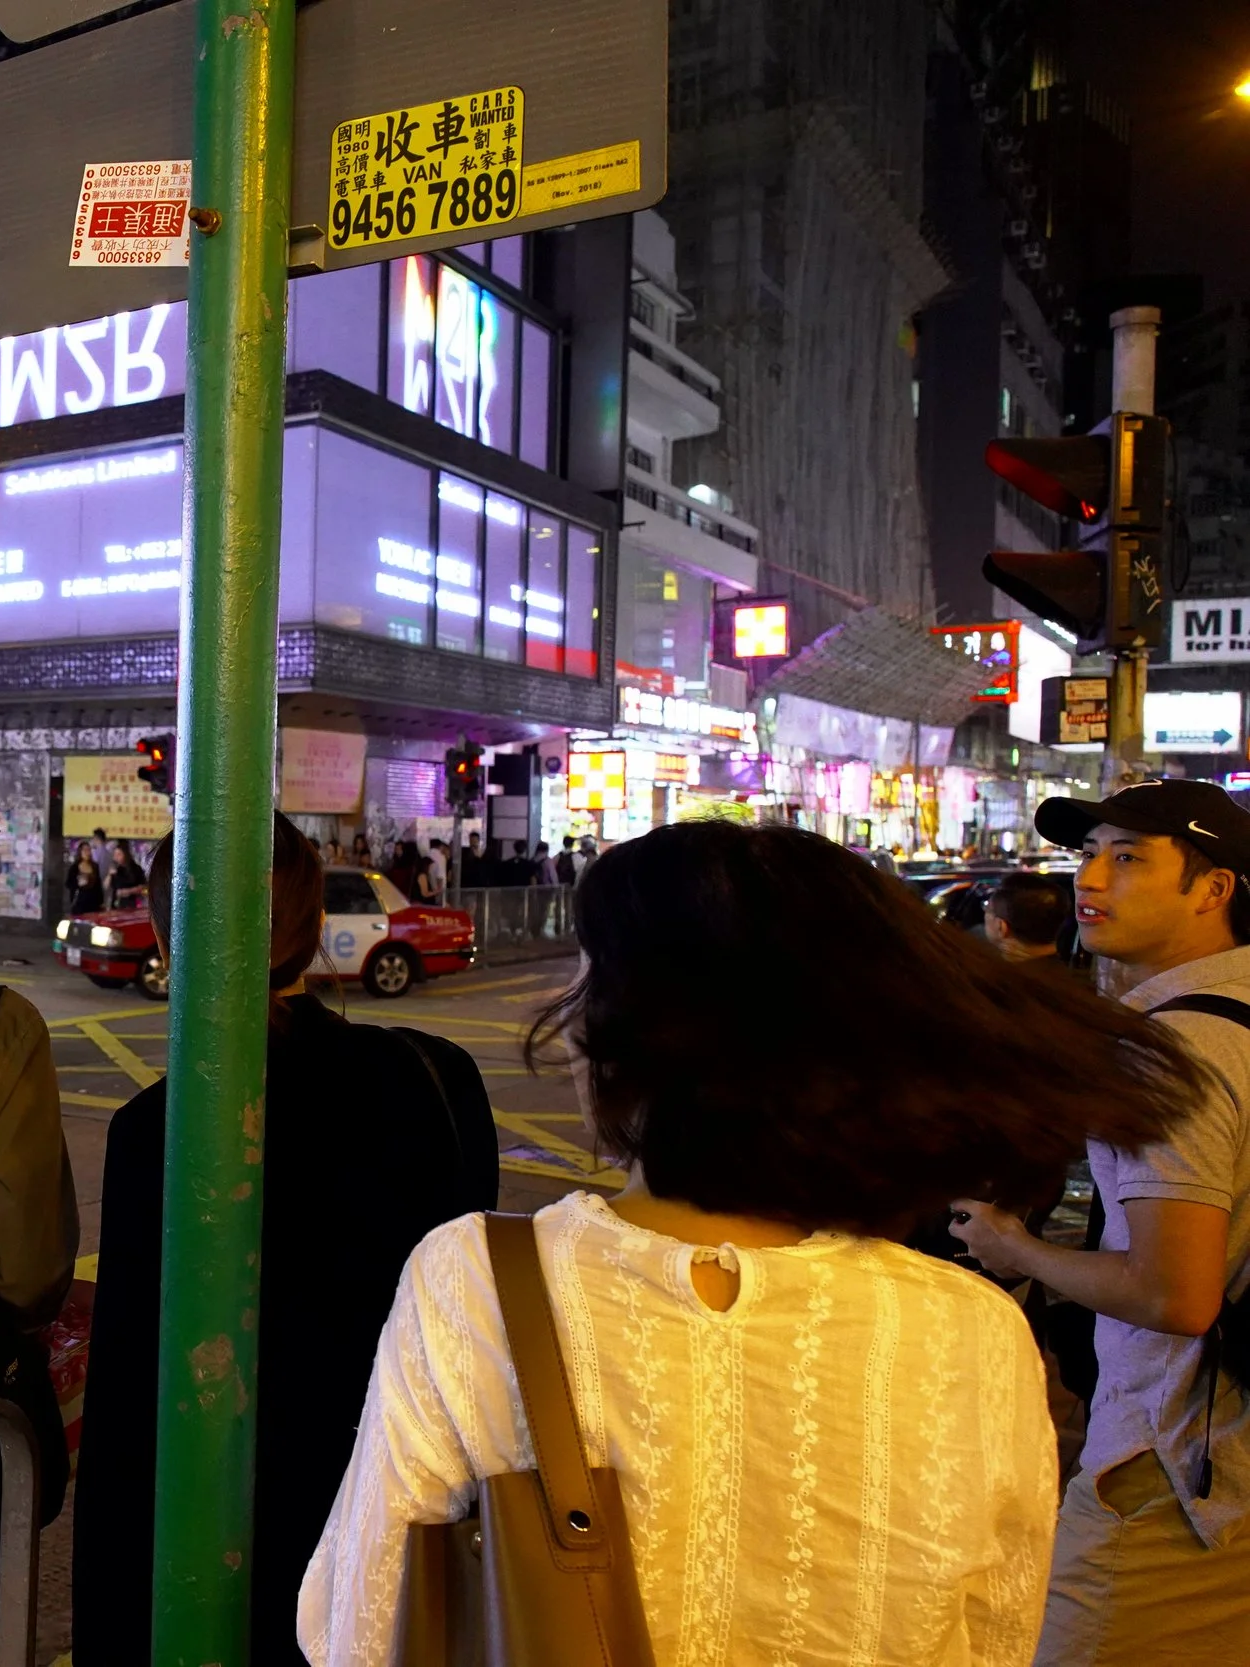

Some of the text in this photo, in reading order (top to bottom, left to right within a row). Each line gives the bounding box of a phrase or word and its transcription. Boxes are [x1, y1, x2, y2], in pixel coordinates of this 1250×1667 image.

[470, 89, 515, 113] CARS
[470, 105, 515, 129] WANTED
[337, 119, 371, 144] 國明
[374, 101, 470, 169] 收車
[337, 139, 369, 155] 1980
[99, 164, 161, 178] 68335000
[335, 152, 370, 177] 高價
[459, 146, 518, 175] 私家車
[334, 170, 388, 198] 電單車
[403, 161, 442, 185] VAN
[551, 180, 602, 199] (Nov. 2018)
[94, 203, 183, 235] 通渠王
[332, 168, 517, 247] 9456 7889
[97, 251, 162, 264] 68335000
[96, 449, 177, 482] Limited
[1186, 639, 1223, 651] for
